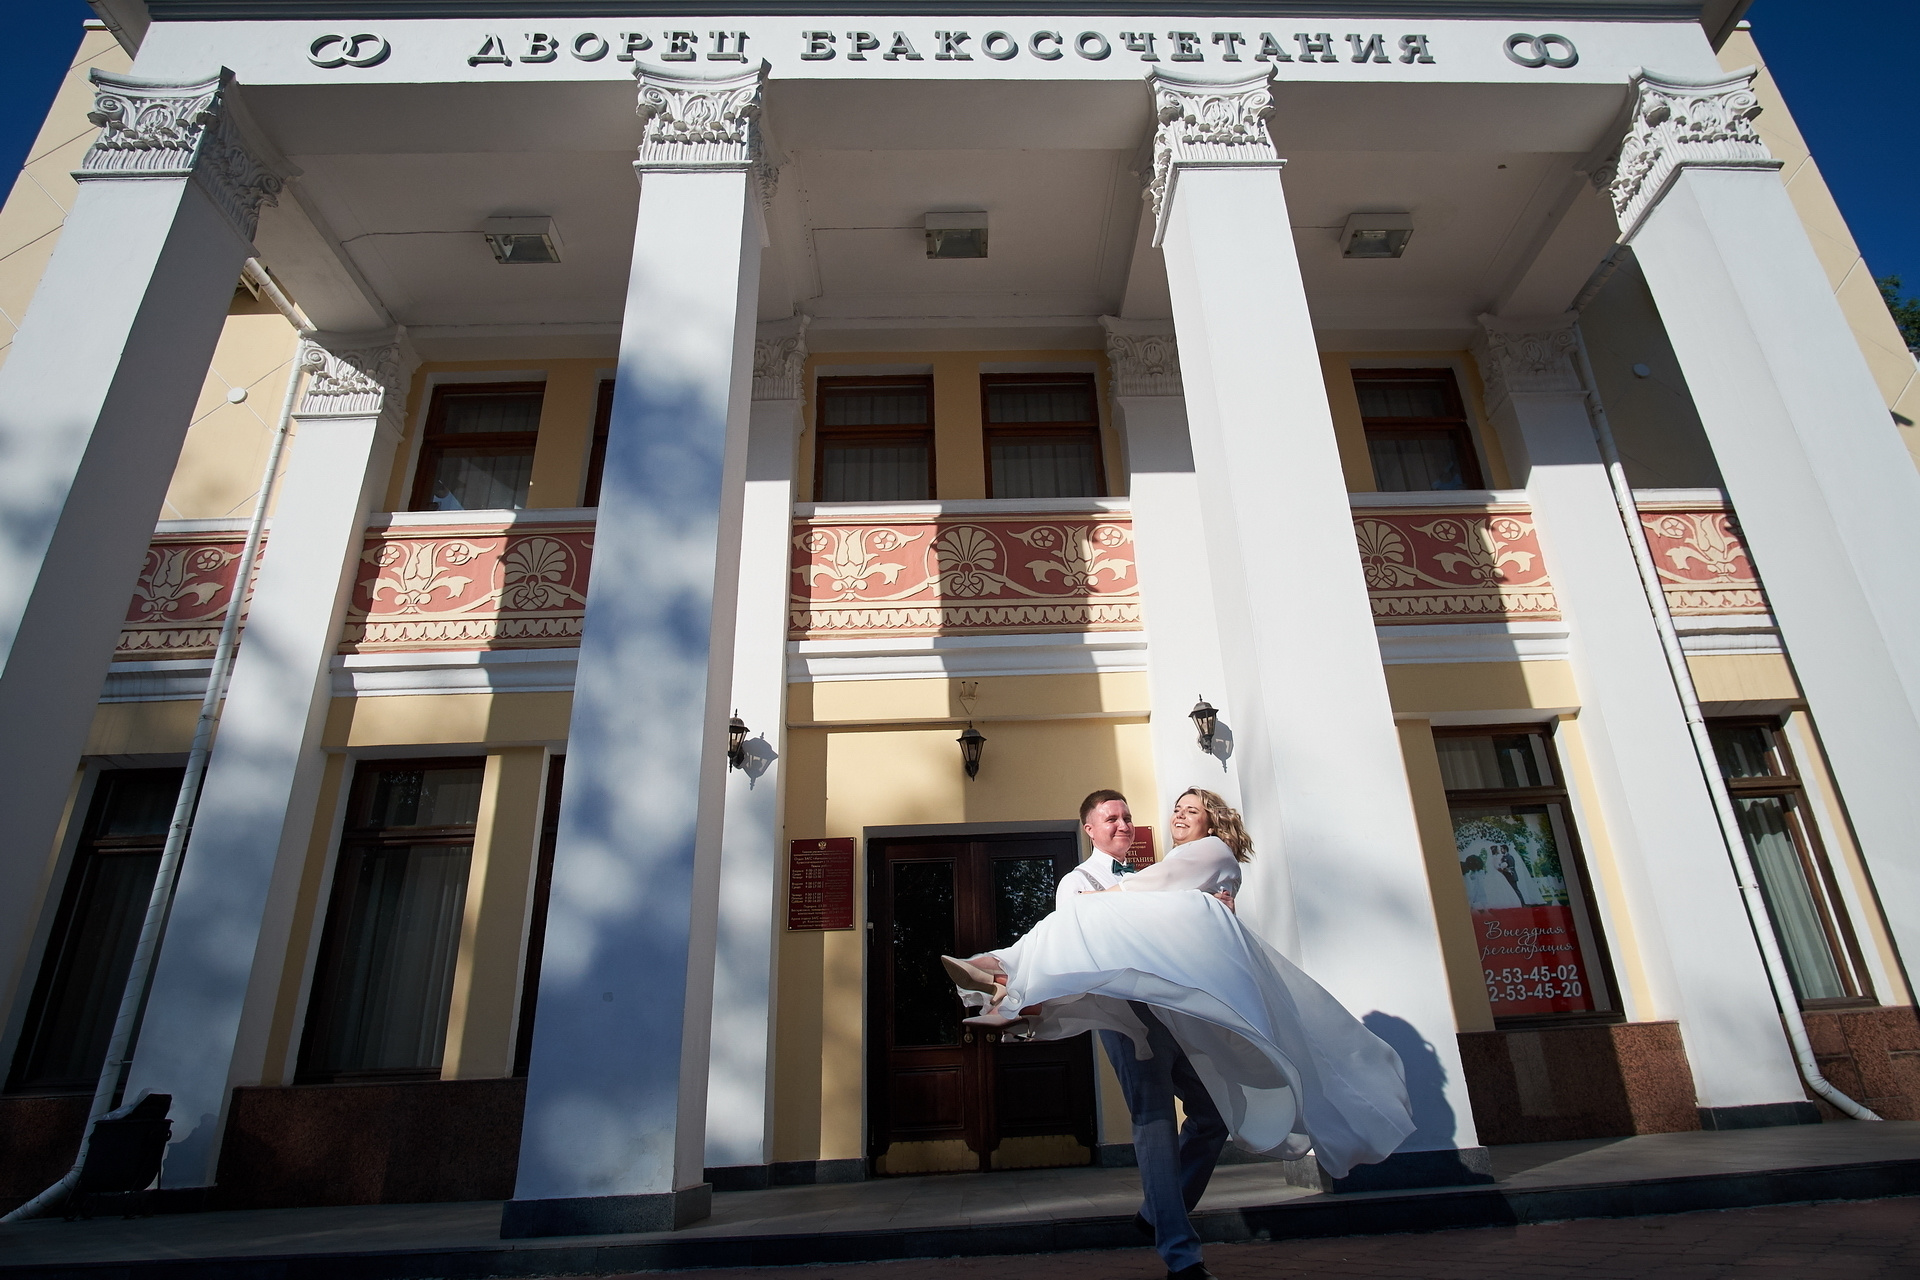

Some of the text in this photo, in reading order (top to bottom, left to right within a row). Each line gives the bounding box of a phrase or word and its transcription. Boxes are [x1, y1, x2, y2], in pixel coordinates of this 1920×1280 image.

[467, 30, 1436, 67] ДВОРЕЦ БРАКОСОЧЕТАНИЯ
[1484, 921, 1565, 946] Выездная
[1480, 943, 1575, 962] регистрация
[1485, 964, 1578, 985] 2-53-45-02
[1489, 981, 1582, 1002] 2-53-45-20
